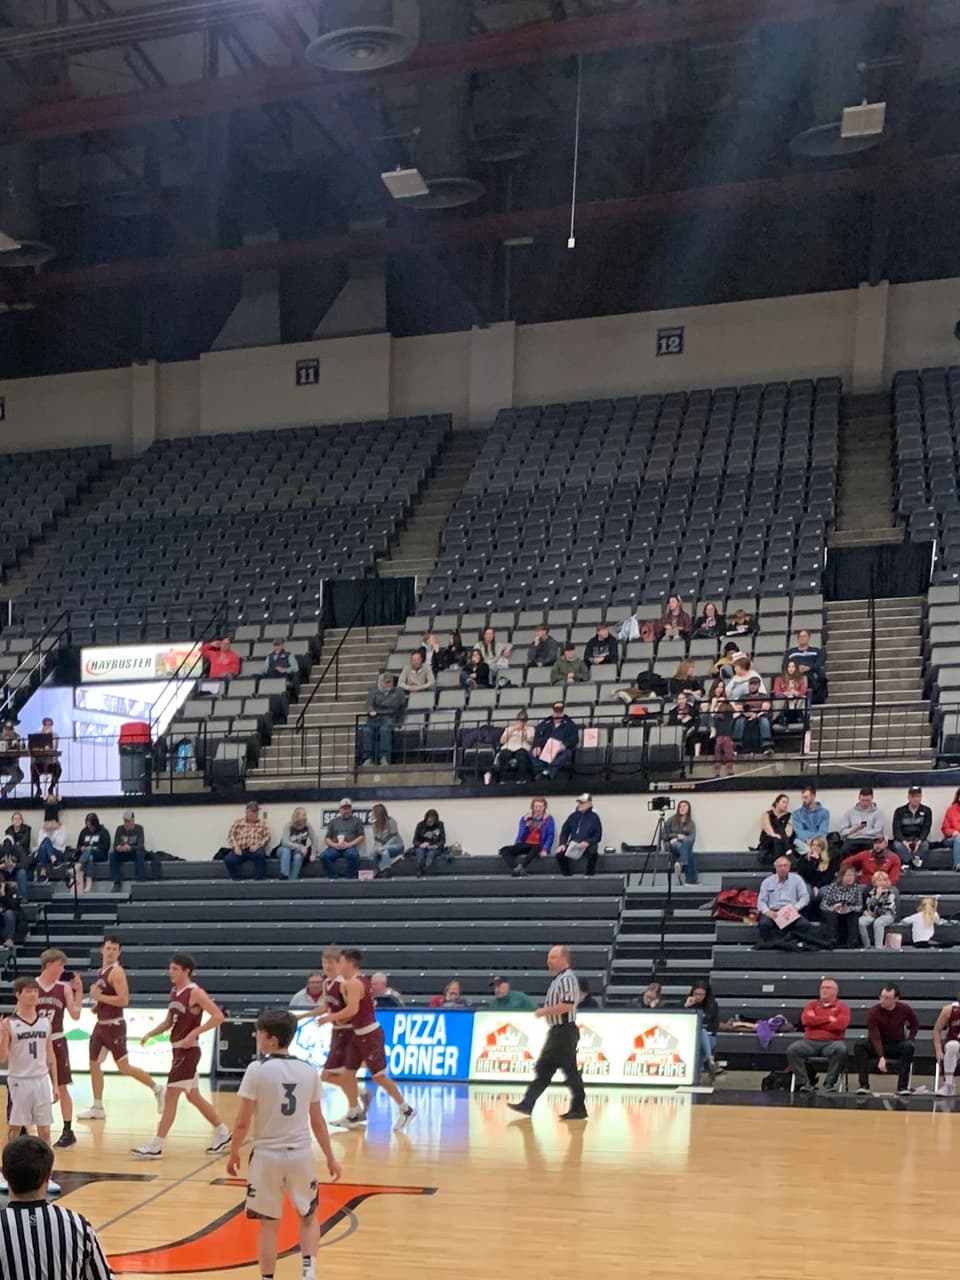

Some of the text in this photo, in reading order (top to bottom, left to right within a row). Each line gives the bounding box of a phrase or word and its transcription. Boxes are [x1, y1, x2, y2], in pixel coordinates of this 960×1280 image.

[659, 336, 681, 353] 12
[299, 368, 315, 384] 11
[91, 658, 152, 671] HAYBUSTER
[392, 1013, 446, 1045] PIZZA
[29, 1041, 37, 1059] 4
[281, 1083, 297, 1116] 3
